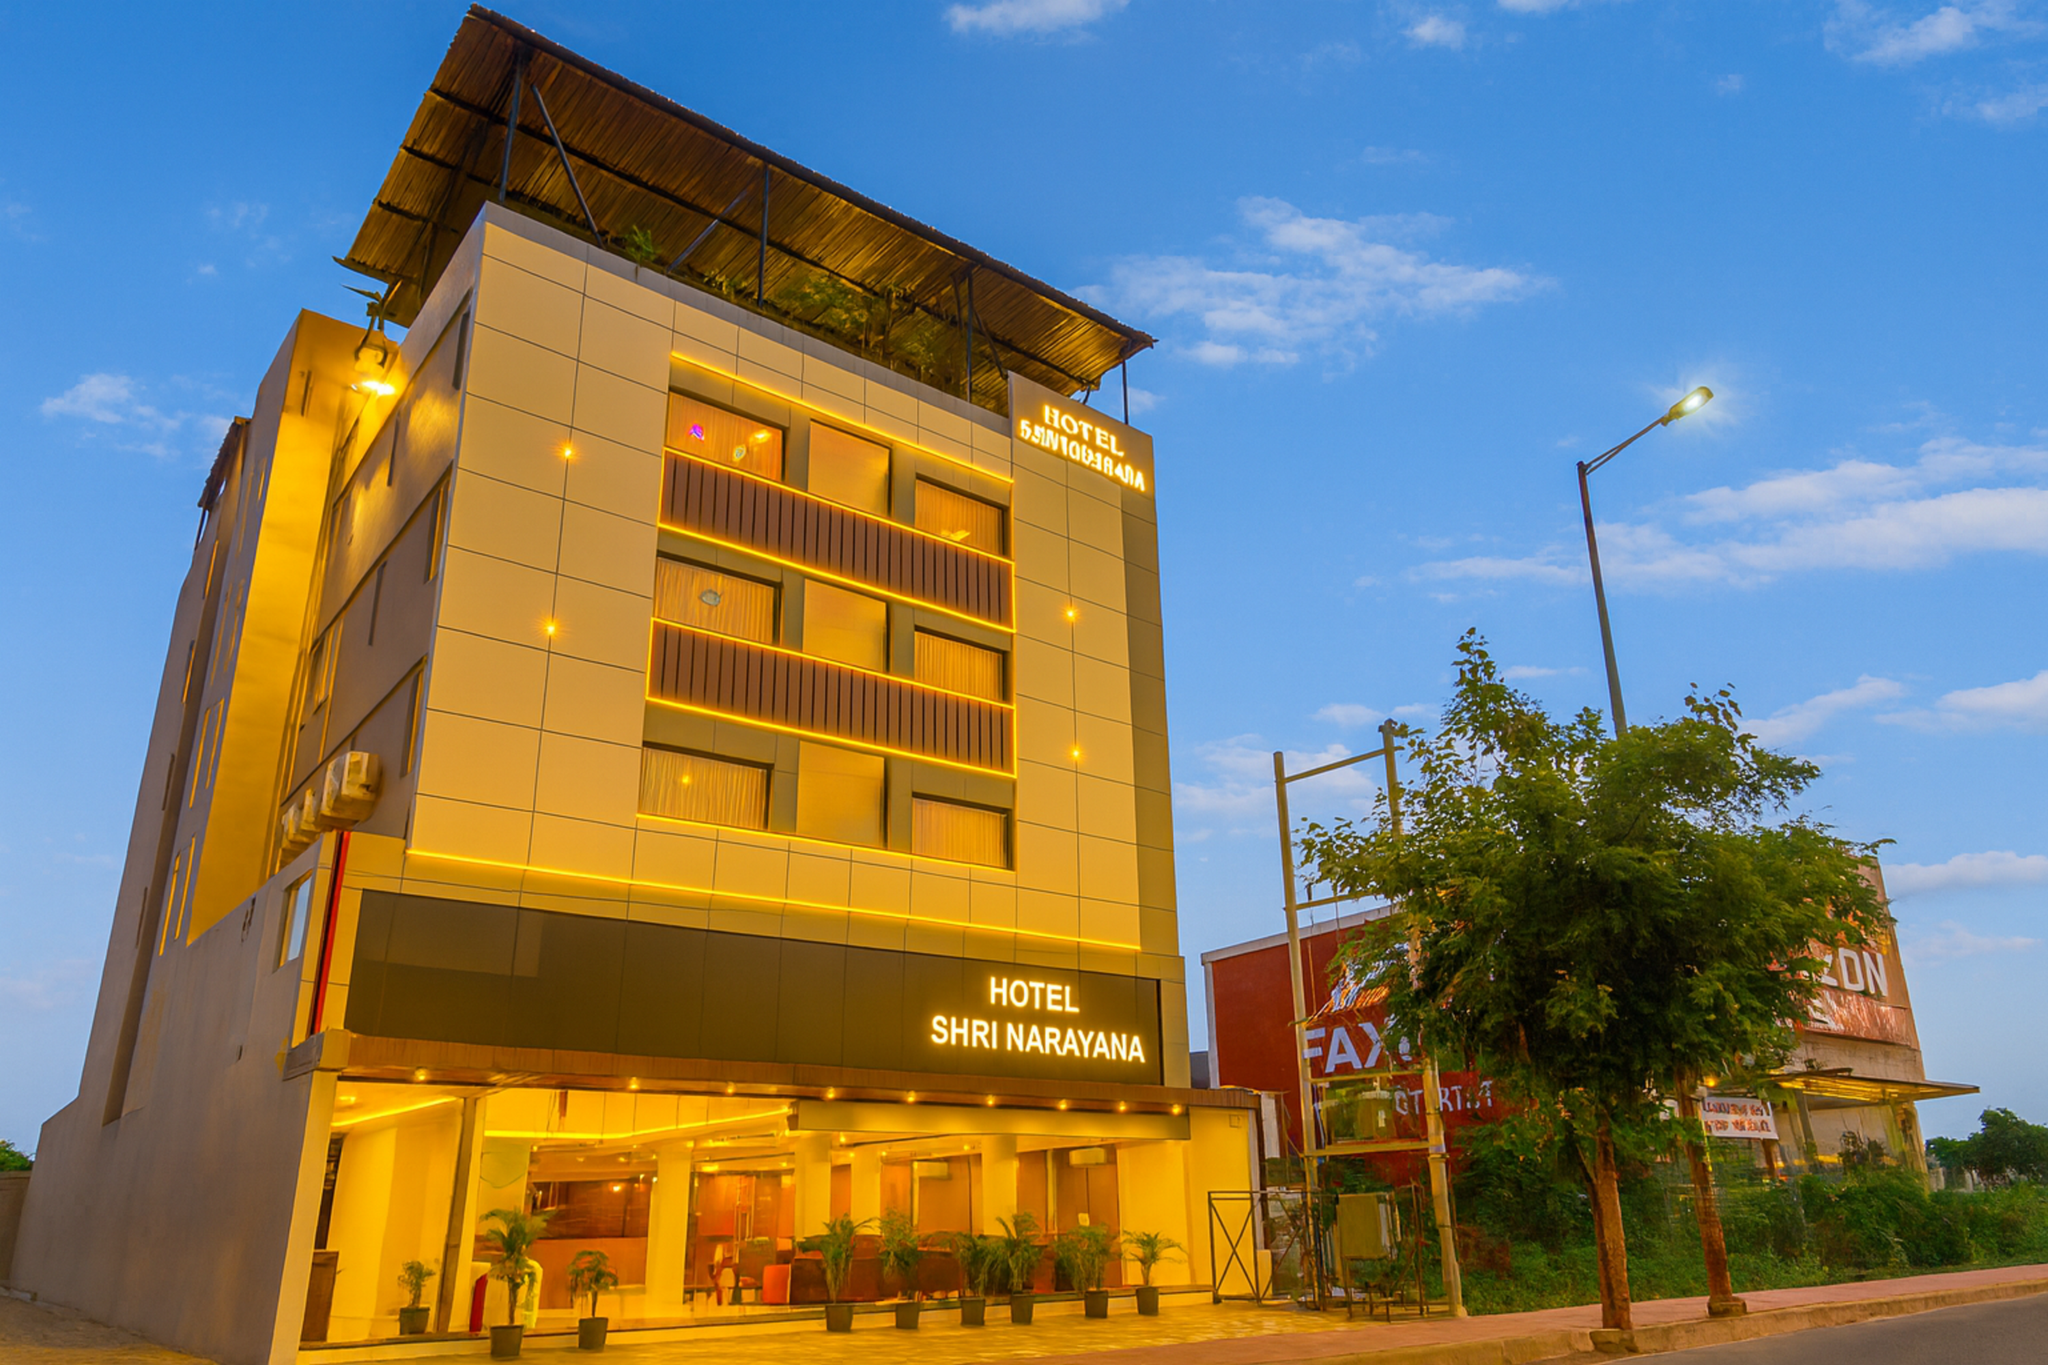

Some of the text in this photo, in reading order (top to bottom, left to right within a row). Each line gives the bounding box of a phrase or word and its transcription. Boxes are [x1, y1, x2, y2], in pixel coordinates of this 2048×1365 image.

[1043, 404, 1125, 458] HOTEL
[989, 976, 1080, 1013] HOTEL
[931, 1015, 1146, 1064] SHRI NARAYANA
